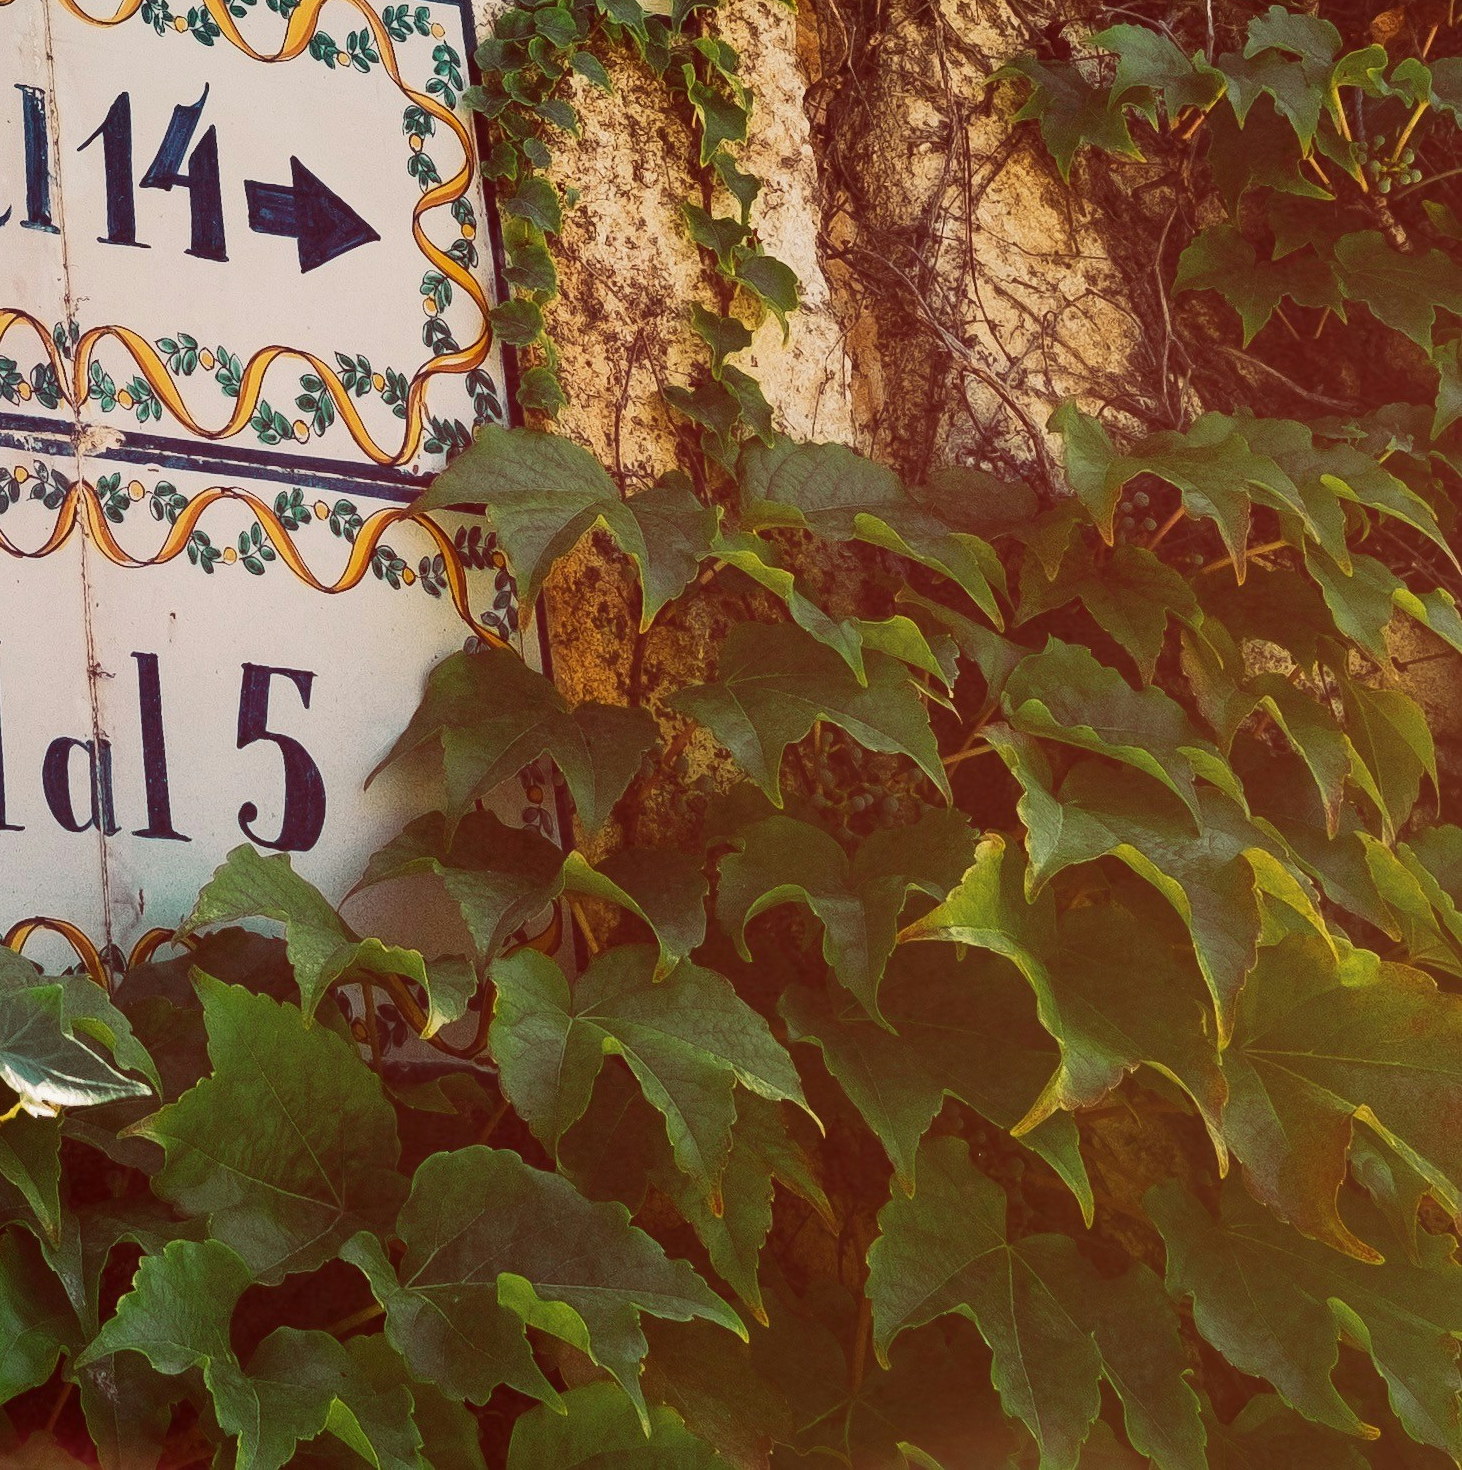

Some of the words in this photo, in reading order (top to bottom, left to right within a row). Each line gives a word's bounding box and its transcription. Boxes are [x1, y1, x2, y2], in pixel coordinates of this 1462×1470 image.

[77, 83, 229, 262] 14
[41, 651, 192, 842] al
[237, 662, 328, 852] 5
